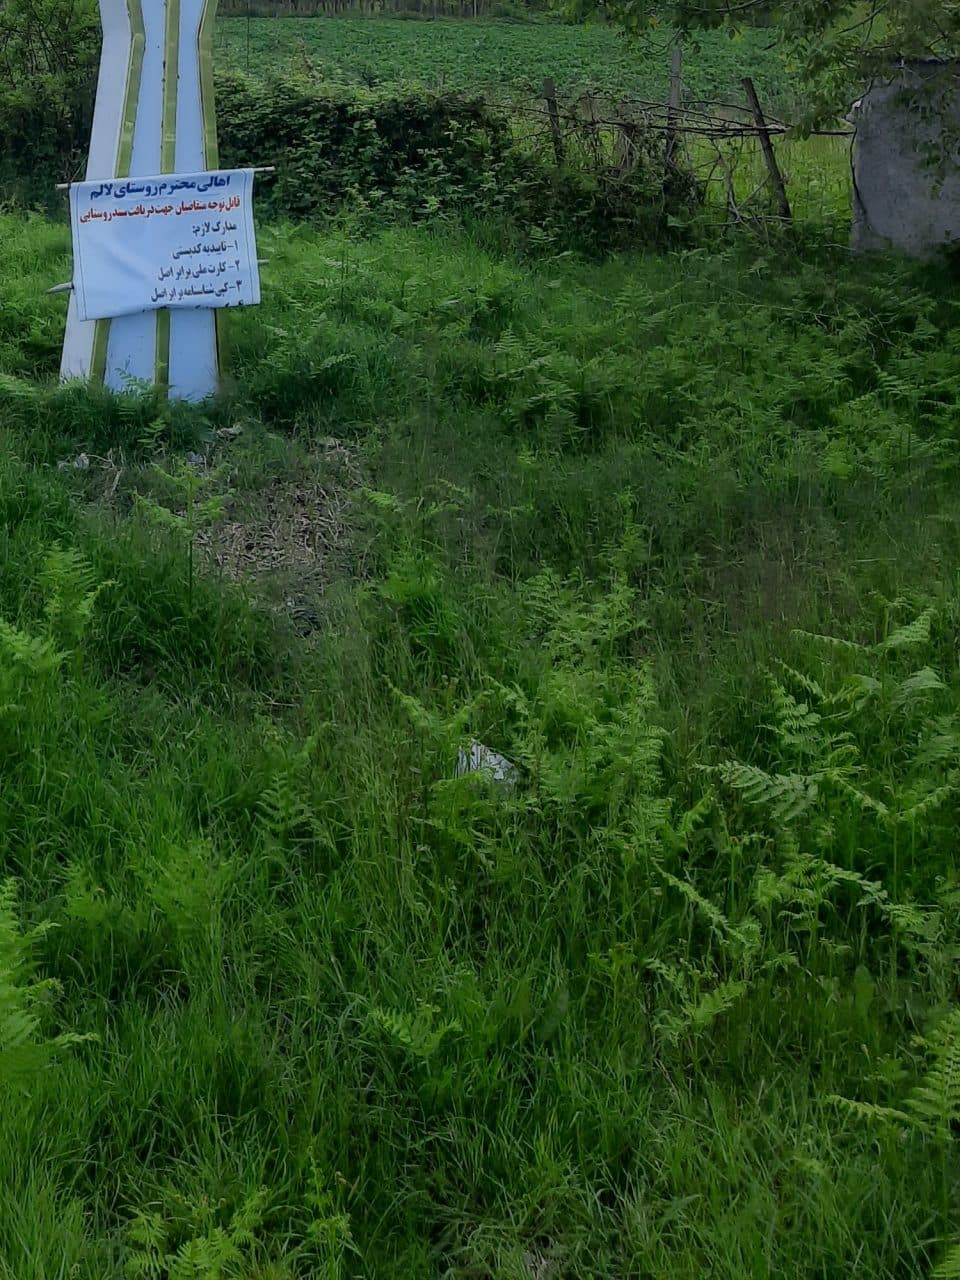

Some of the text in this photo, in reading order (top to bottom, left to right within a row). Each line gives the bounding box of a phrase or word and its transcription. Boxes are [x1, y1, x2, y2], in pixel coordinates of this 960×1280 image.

[90, 175, 231, 200] اهالی محترم روستای لالم
[211, 220, 237, 235] مدارک
